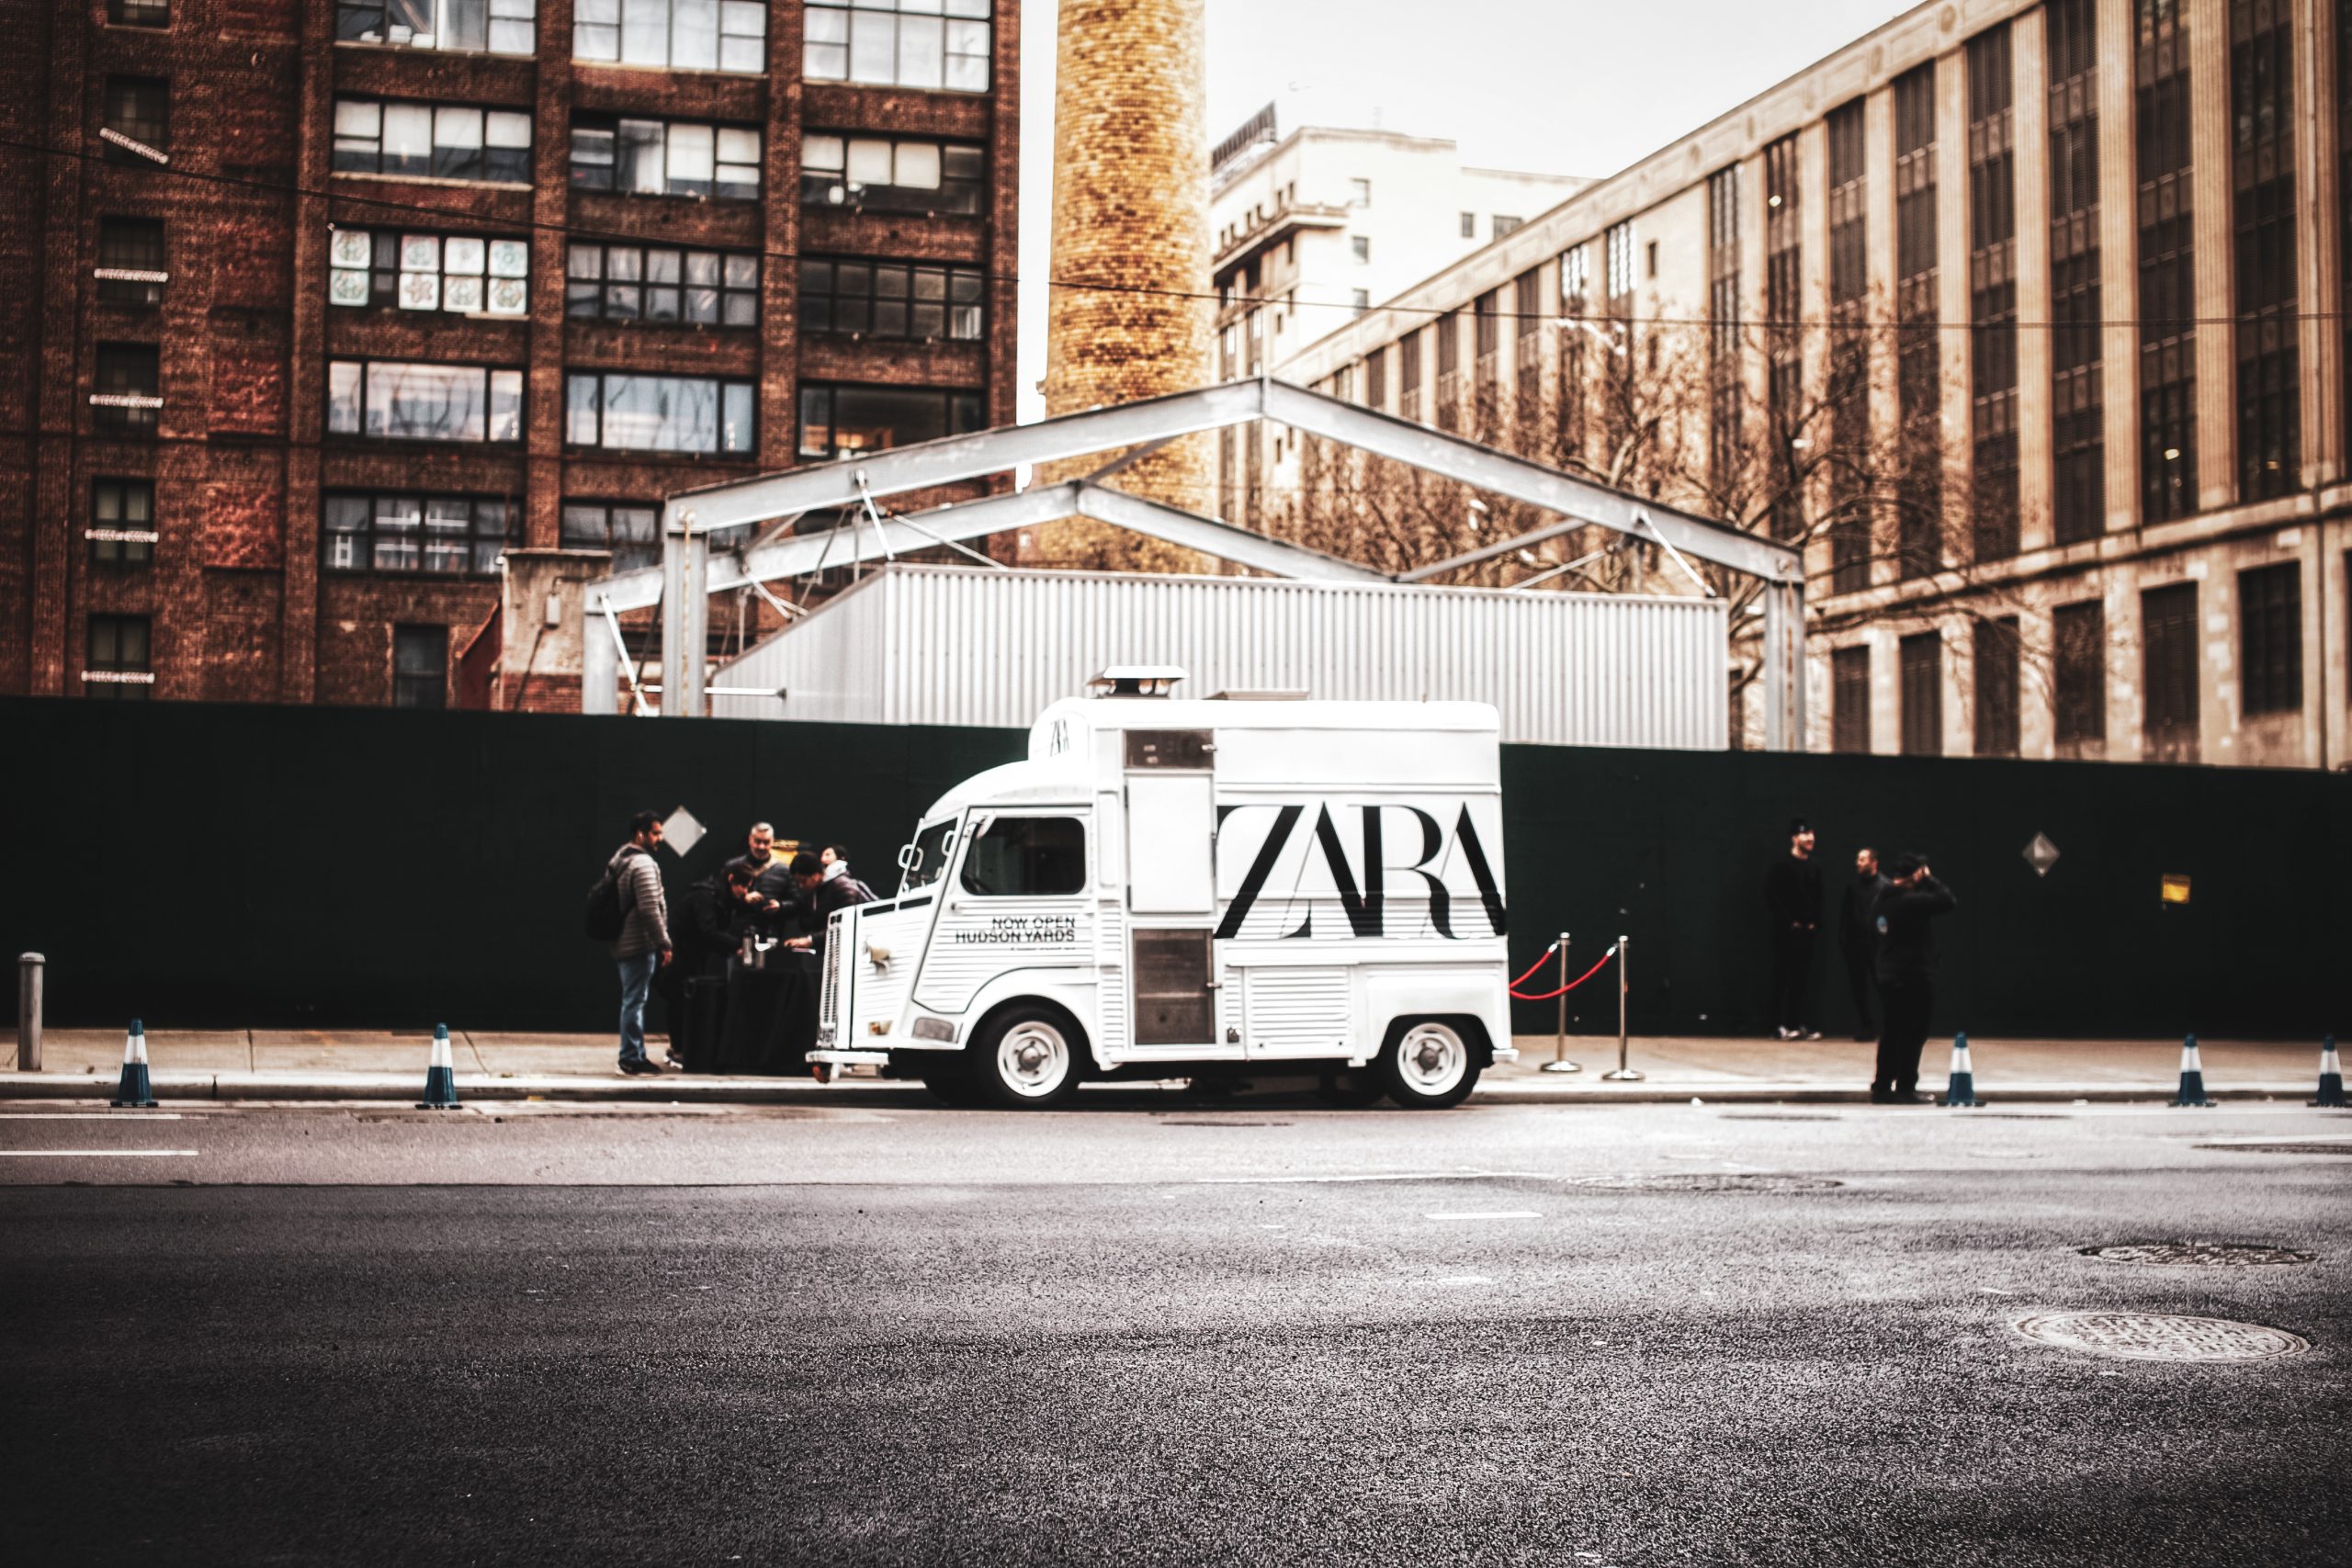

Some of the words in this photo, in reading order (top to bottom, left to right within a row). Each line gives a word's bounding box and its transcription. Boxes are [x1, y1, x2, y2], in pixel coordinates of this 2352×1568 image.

[1214, 801, 1506, 939] ZARA
[992, 917, 1028, 929] NOW
[1033, 916, 1075, 929] OPEN
[956, 931, 1021, 943] HUDSON
[1024, 929, 1075, 942] YARDS
